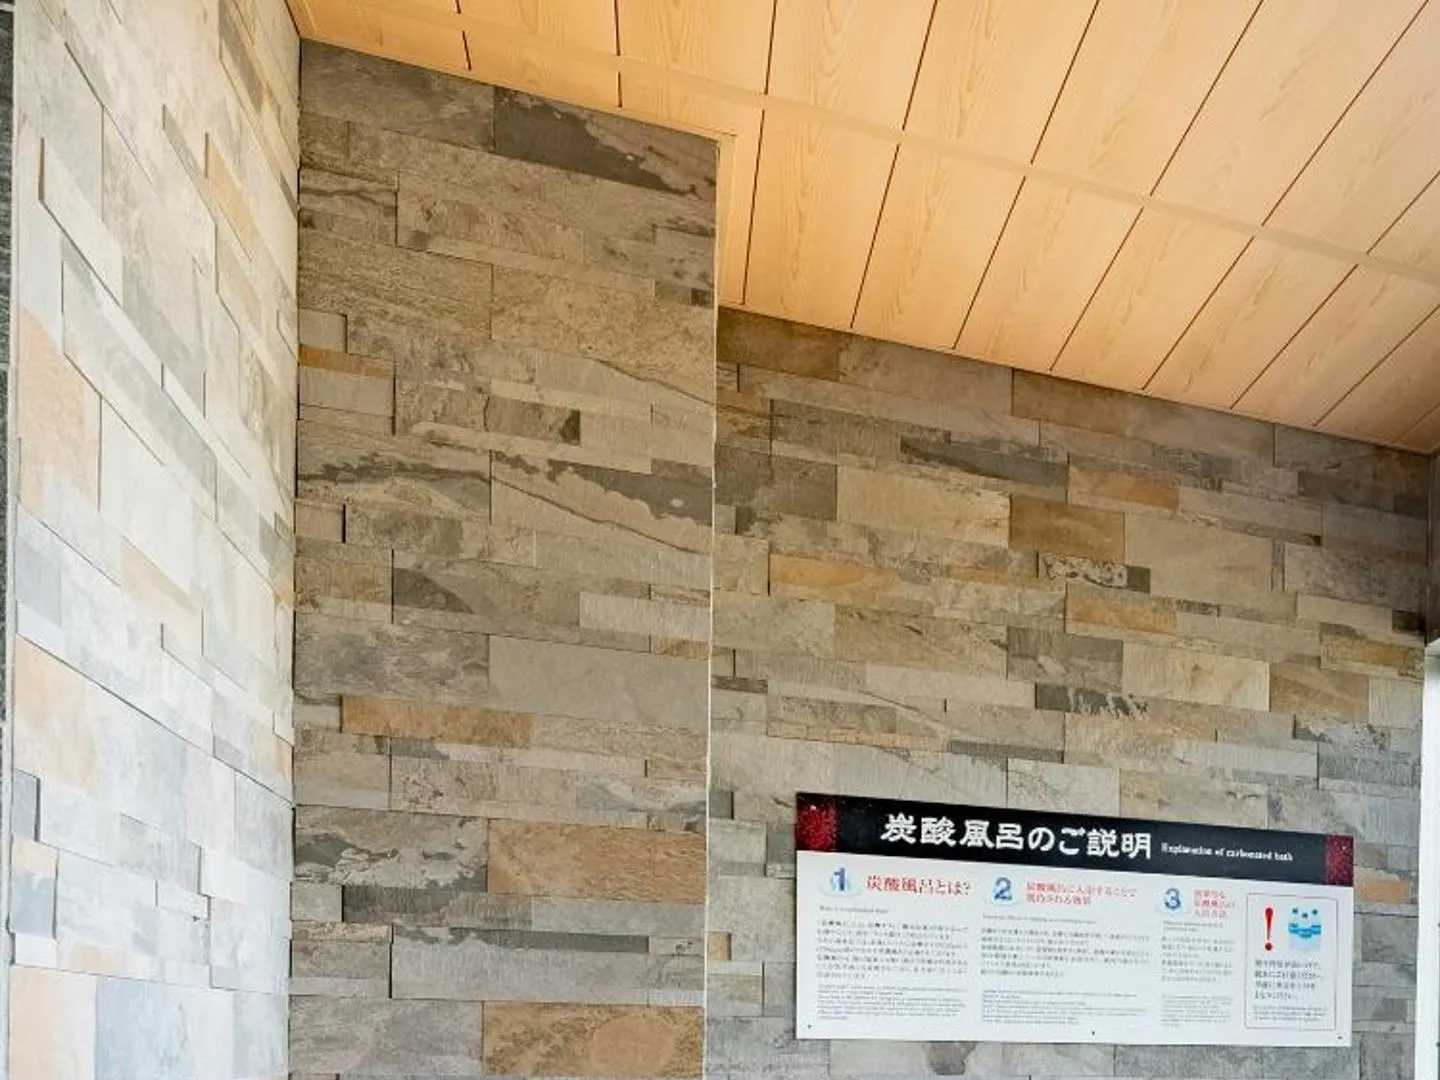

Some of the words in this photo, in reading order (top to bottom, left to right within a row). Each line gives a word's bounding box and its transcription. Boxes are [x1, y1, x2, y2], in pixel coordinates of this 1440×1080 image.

[880, 813, 1152, 860] 炭酸風呂のご説明
[993, 876, 1013, 902] 2
[1164, 887, 1182, 911] 3
